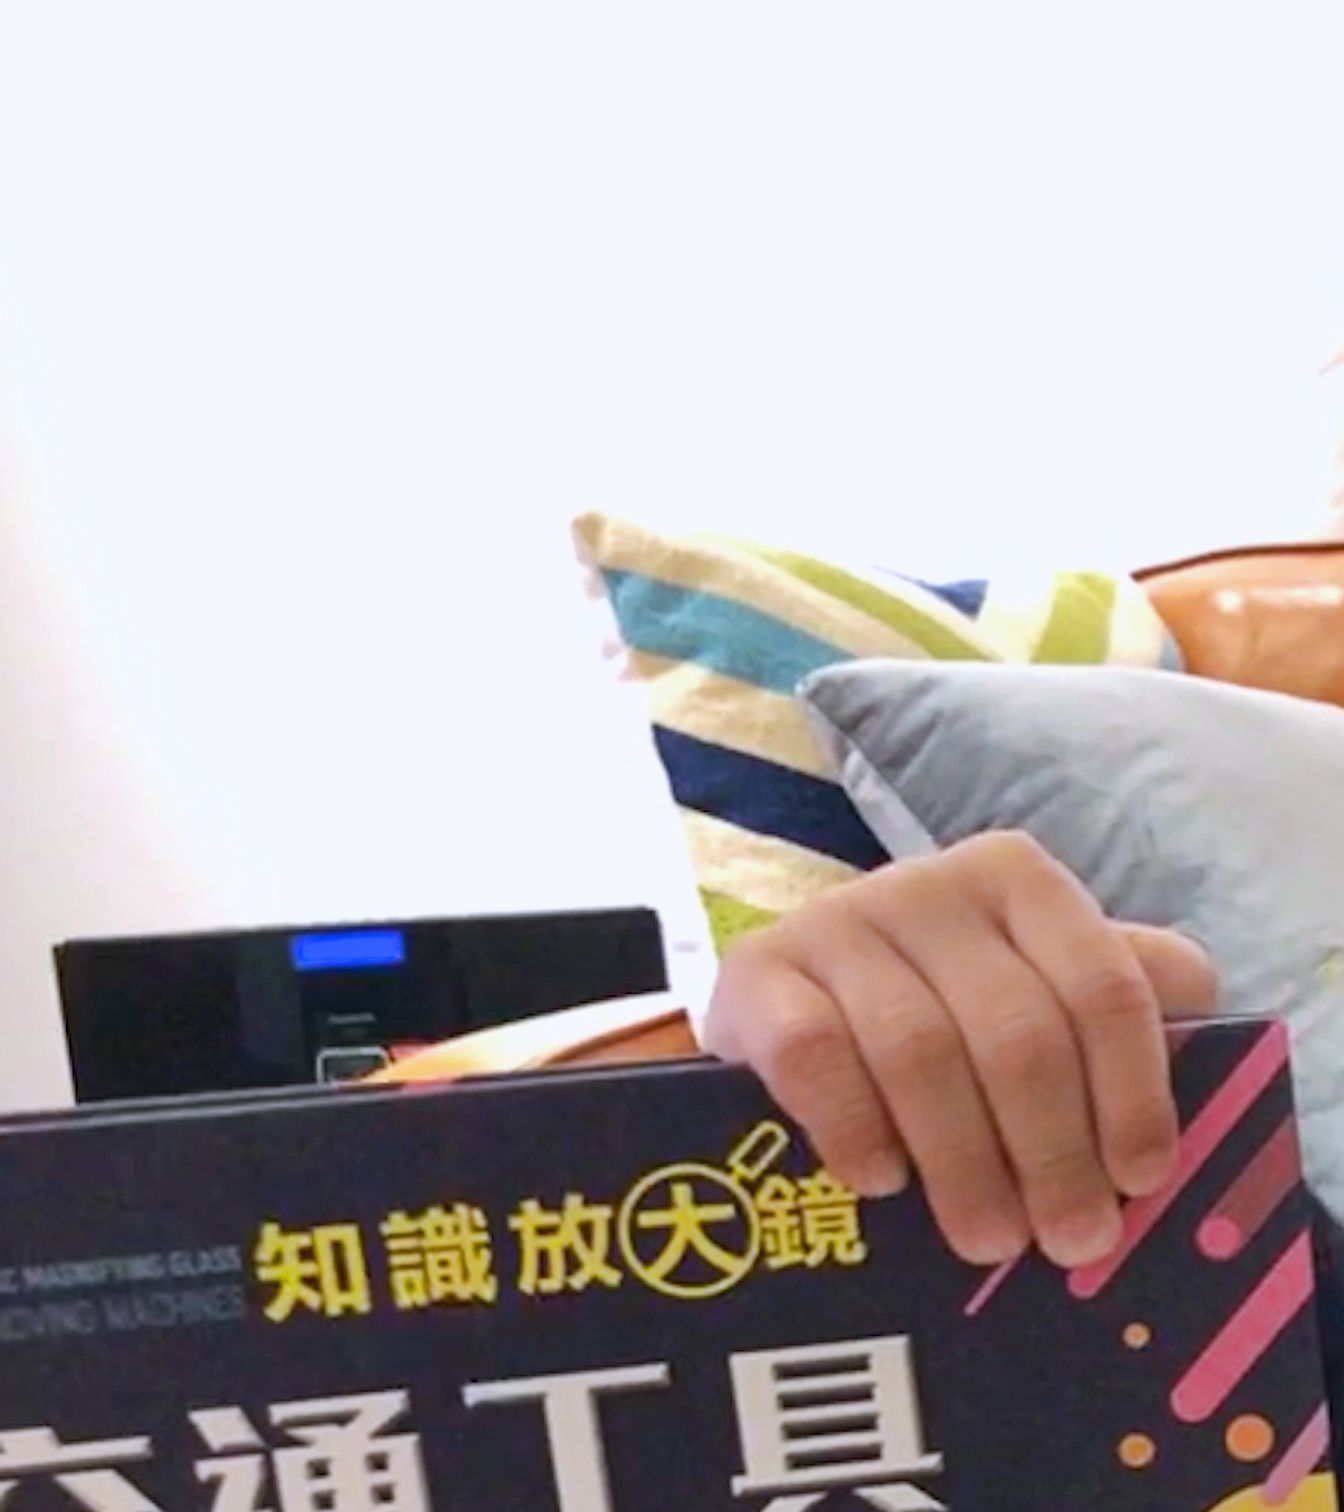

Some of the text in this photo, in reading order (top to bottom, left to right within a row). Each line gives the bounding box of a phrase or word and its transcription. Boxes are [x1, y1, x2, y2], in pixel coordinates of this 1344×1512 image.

[253, 1163, 870, 1324] 知識放大鏡
